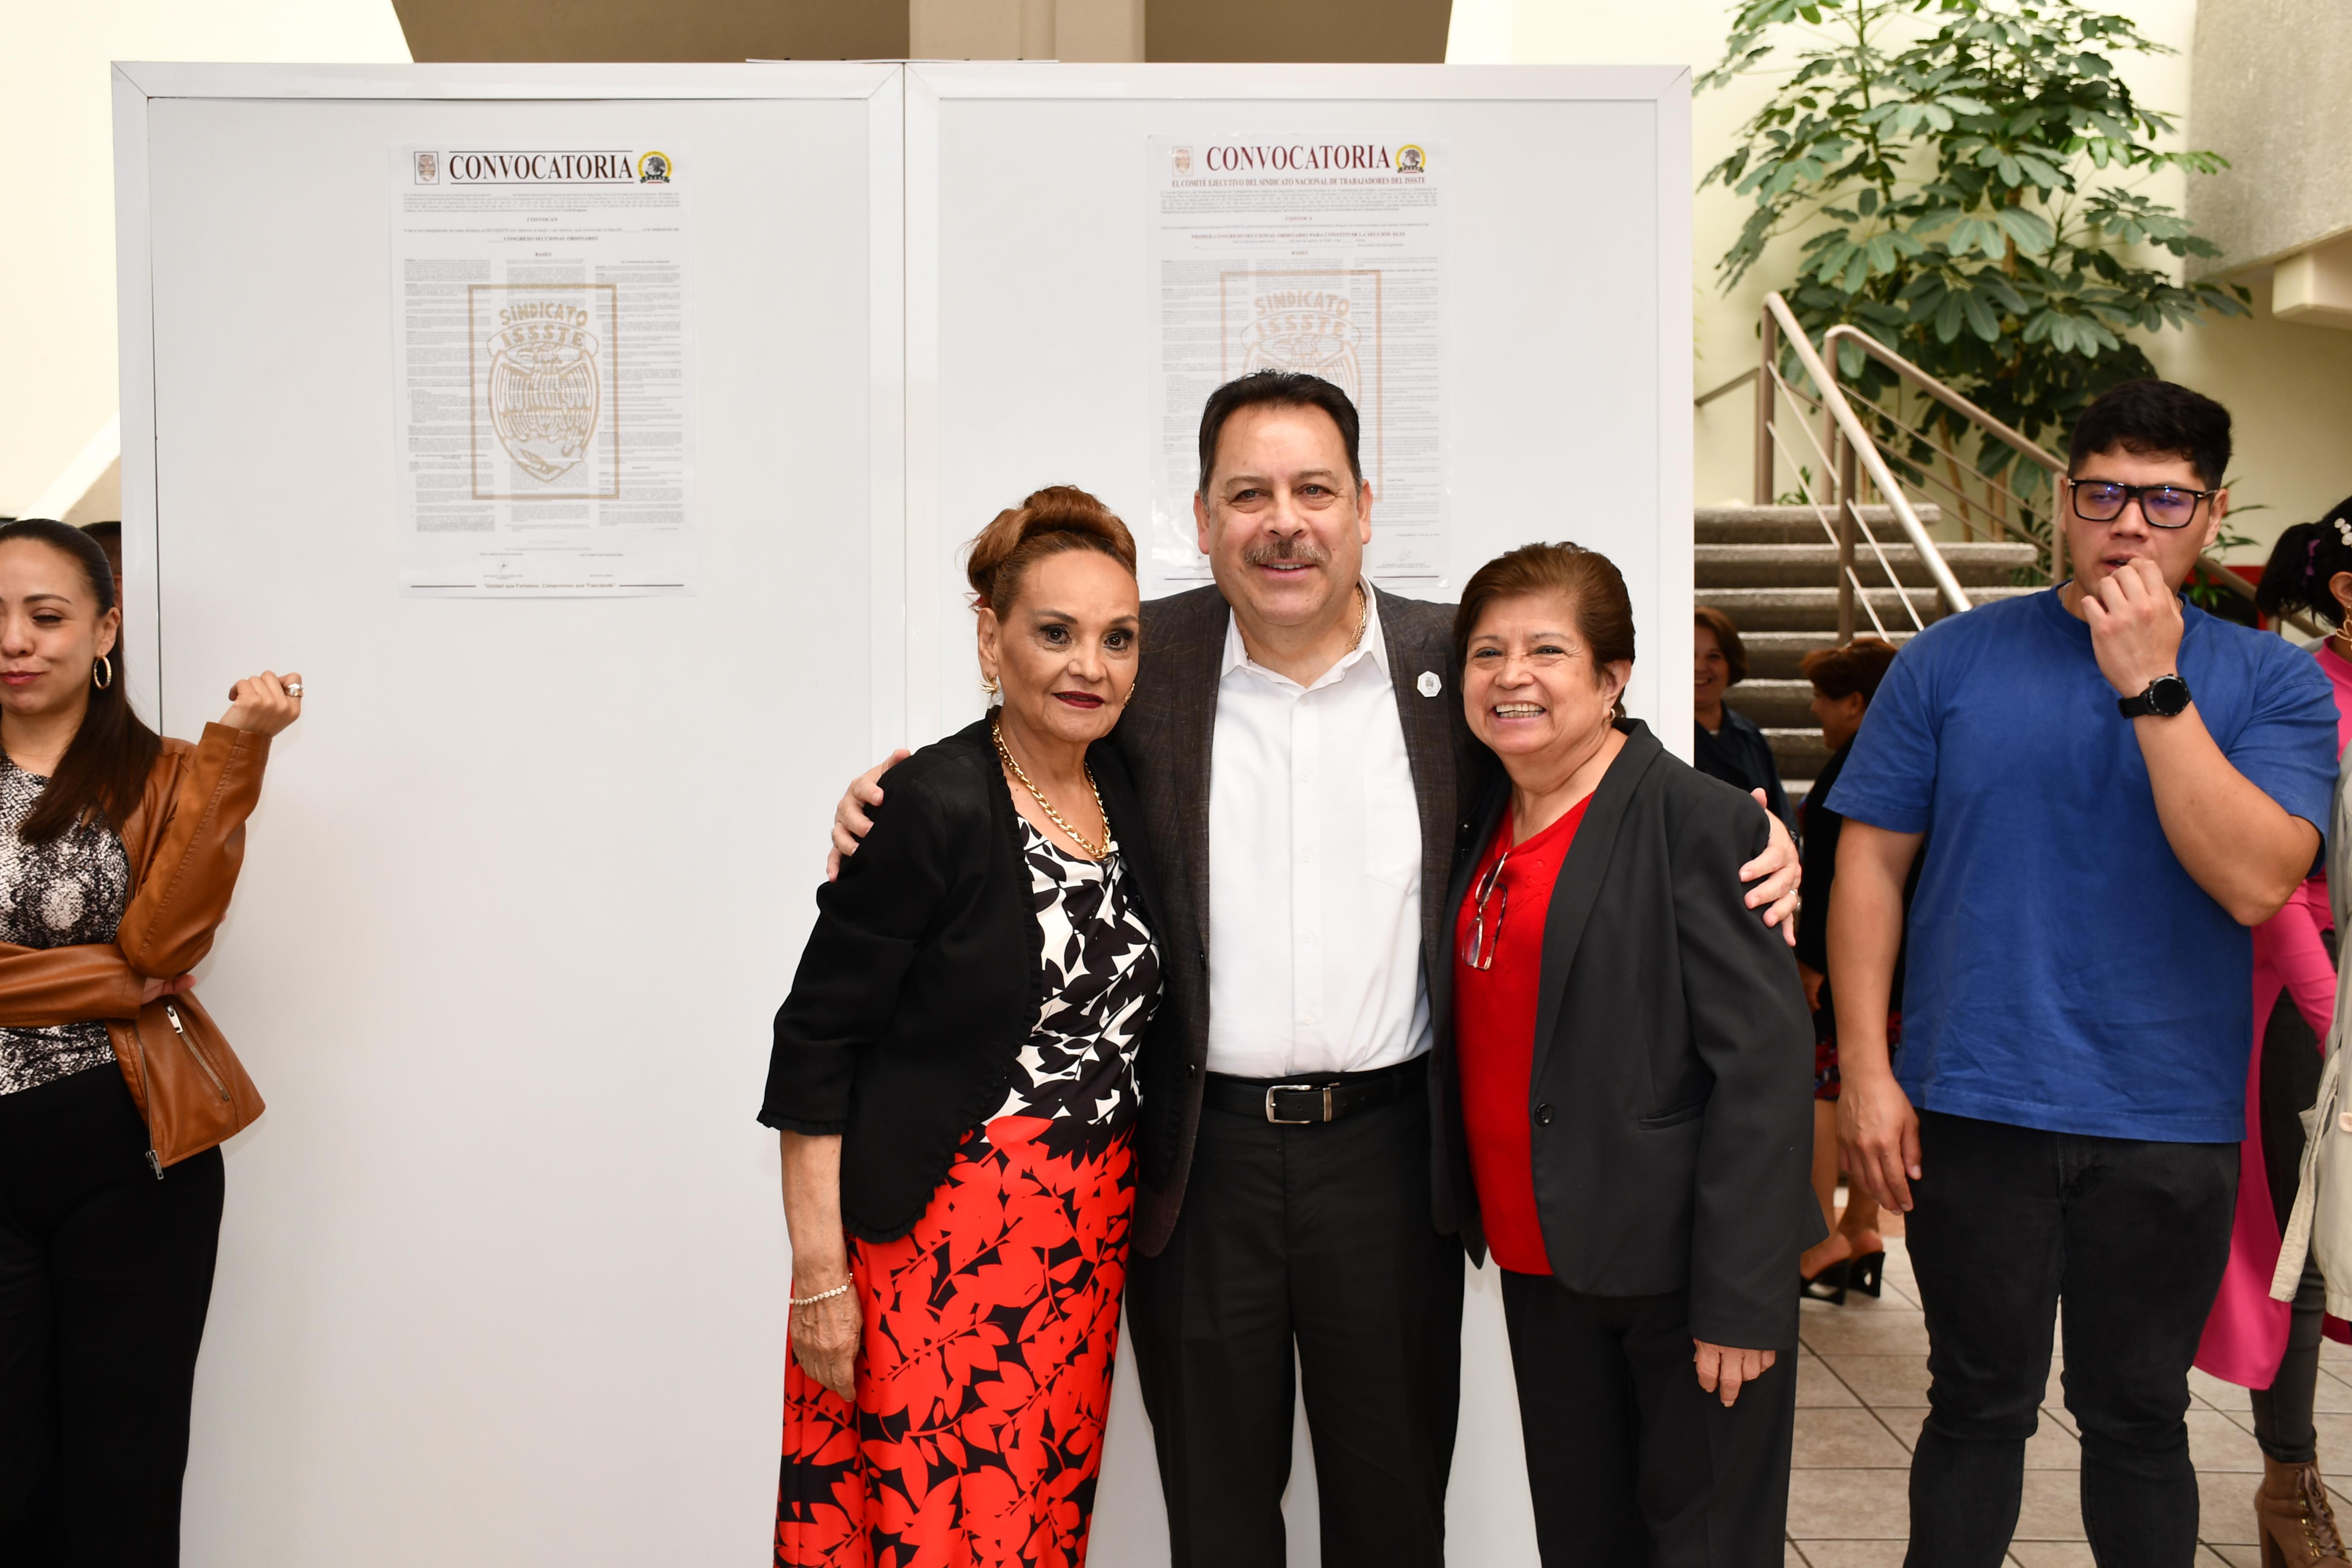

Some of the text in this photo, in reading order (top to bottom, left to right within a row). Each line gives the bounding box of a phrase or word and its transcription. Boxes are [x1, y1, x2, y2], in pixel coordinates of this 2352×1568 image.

[449, 155, 633, 180] CONVOCATORIA
[1206, 145, 1390, 171] CONVOCATORIA
[1172, 180, 1180, 188] EL
[1208, 179, 1245, 187] EJECUTIVO
[1259, 178, 1294, 186] SINDICATO
[499, 302, 588, 327] SINDICATO
[1254, 290, 1350, 315] SINDICATO
[501, 325, 585, 346] ISSSTE
[1256, 314, 1346, 339] ISSSTE
